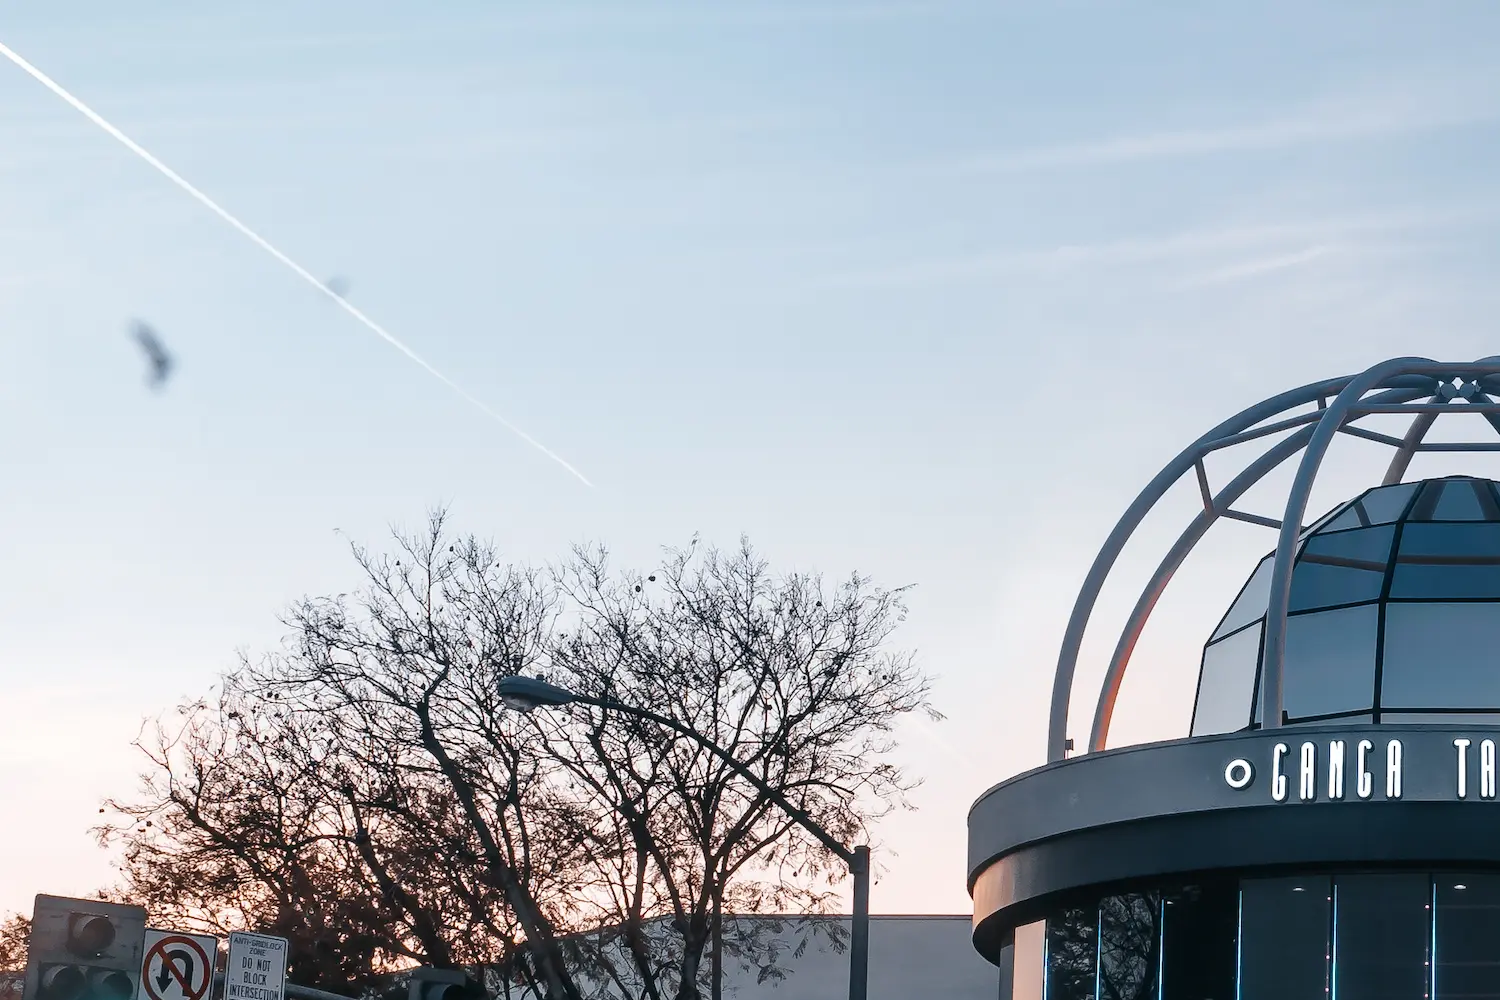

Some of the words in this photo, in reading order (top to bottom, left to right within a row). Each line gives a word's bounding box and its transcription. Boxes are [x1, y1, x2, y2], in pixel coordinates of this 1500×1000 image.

[1272, 739, 1402, 801] GANGA
[234, 937, 283, 951] ANTI-GRIDLOCK
[249, 947, 267, 957] ZONE
[242, 957, 253, 969] DO
[257, 959, 271, 972] NOT
[244, 971, 267, 986] BLOCK
